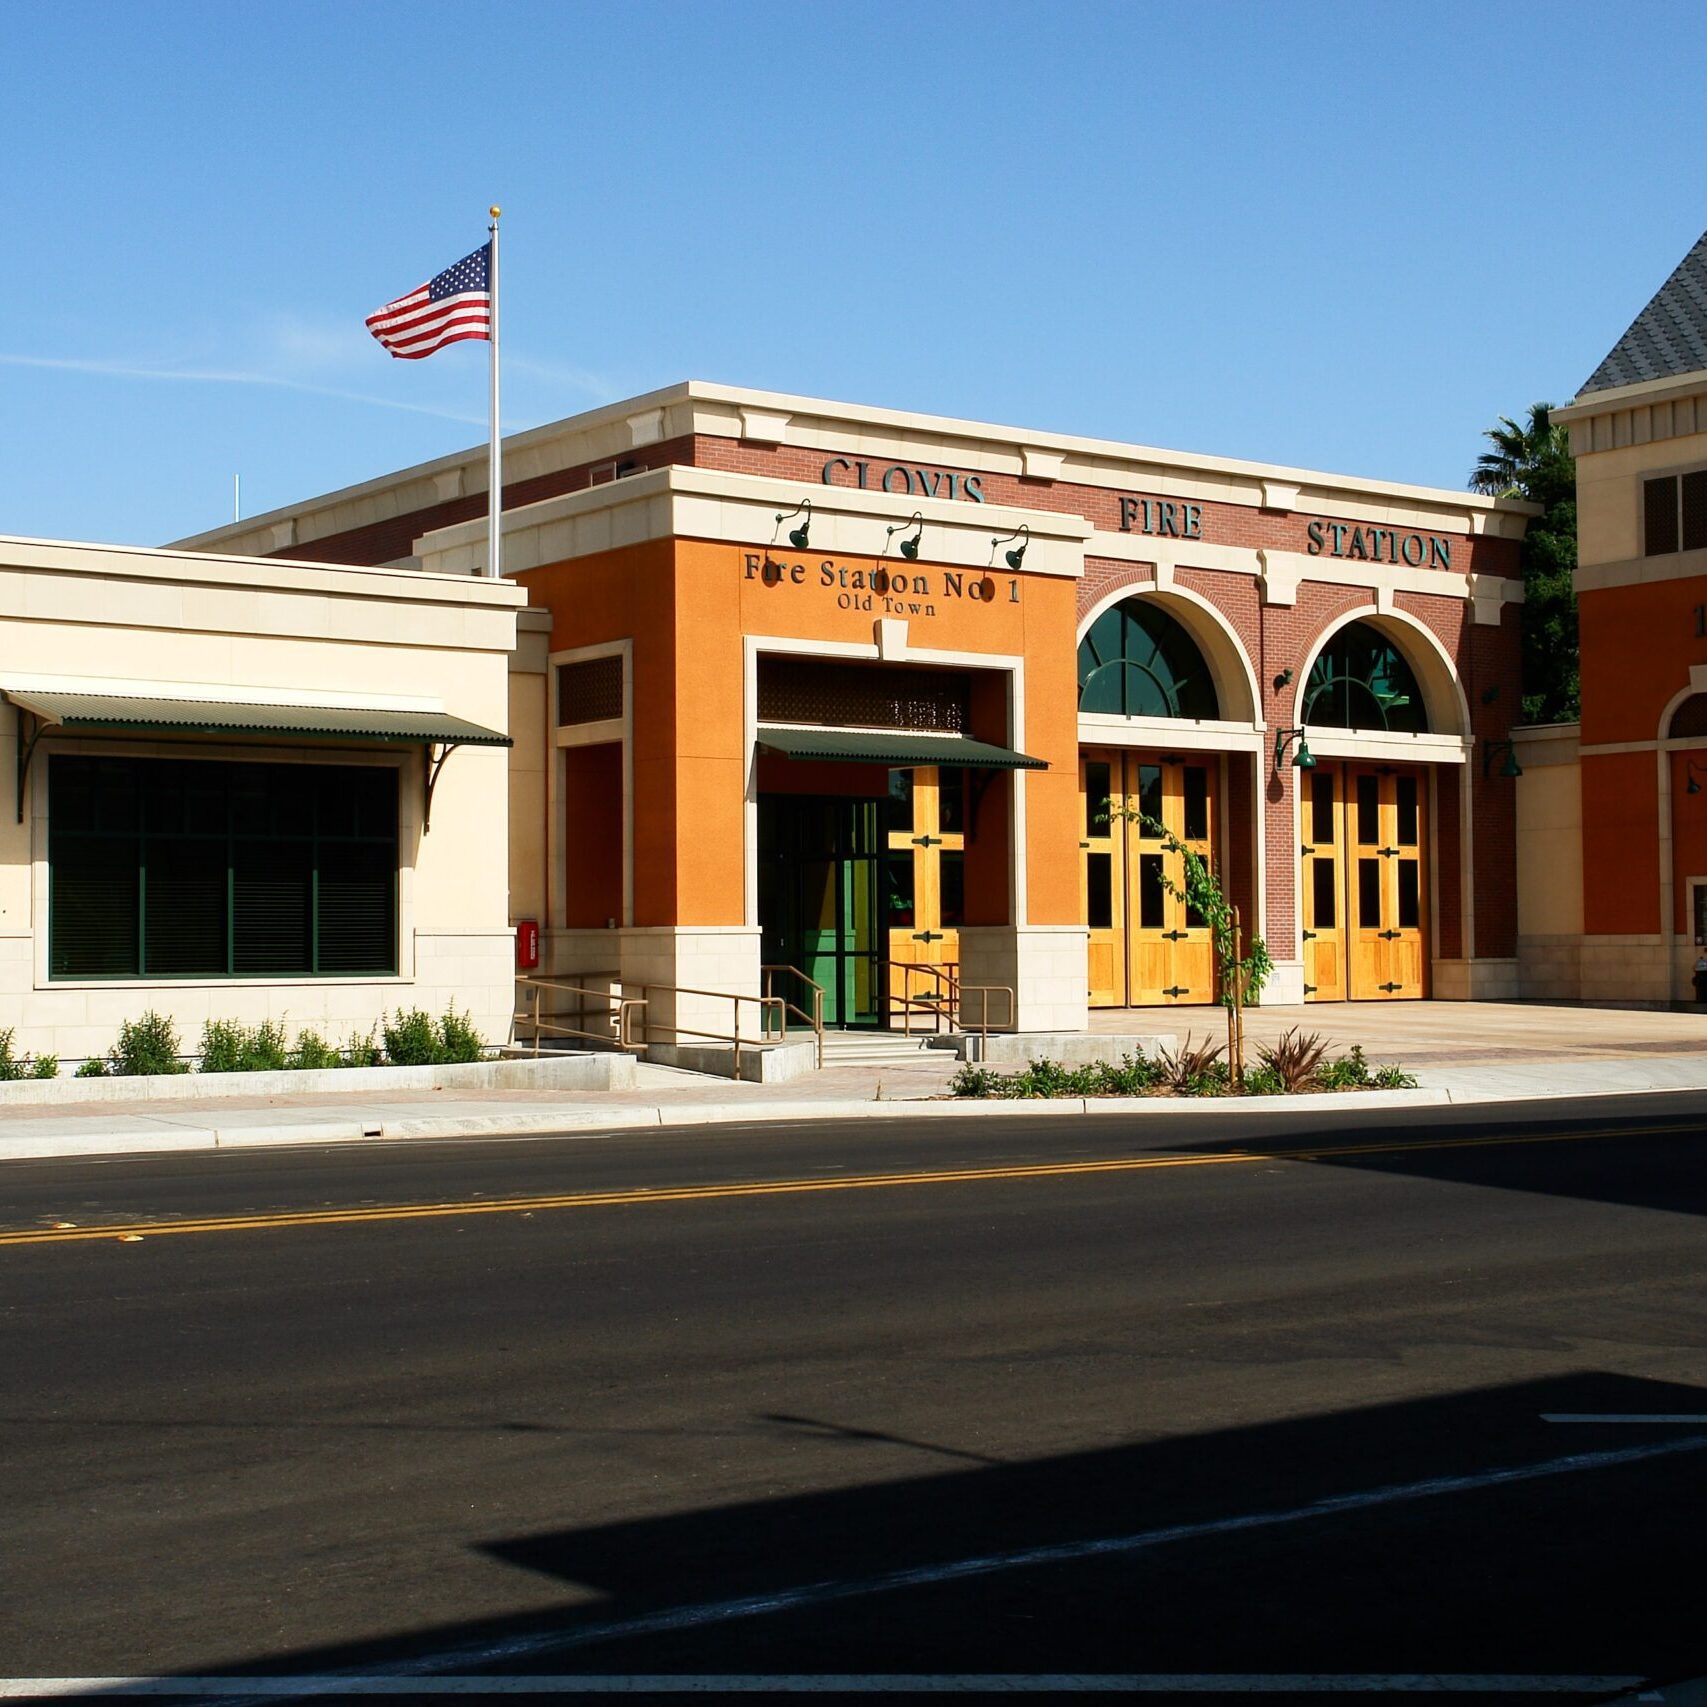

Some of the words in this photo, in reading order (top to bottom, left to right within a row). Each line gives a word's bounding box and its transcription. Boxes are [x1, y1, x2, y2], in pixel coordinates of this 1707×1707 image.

[1118, 496, 1203, 540] FIRE
[1307, 521, 1452, 570] STATION
[744, 553, 806, 584] Fire
[821, 560, 929, 595] Station
[1008, 579, 1020, 603] 1
[837, 593, 872, 611] Old
[882, 597, 936, 616] Town
